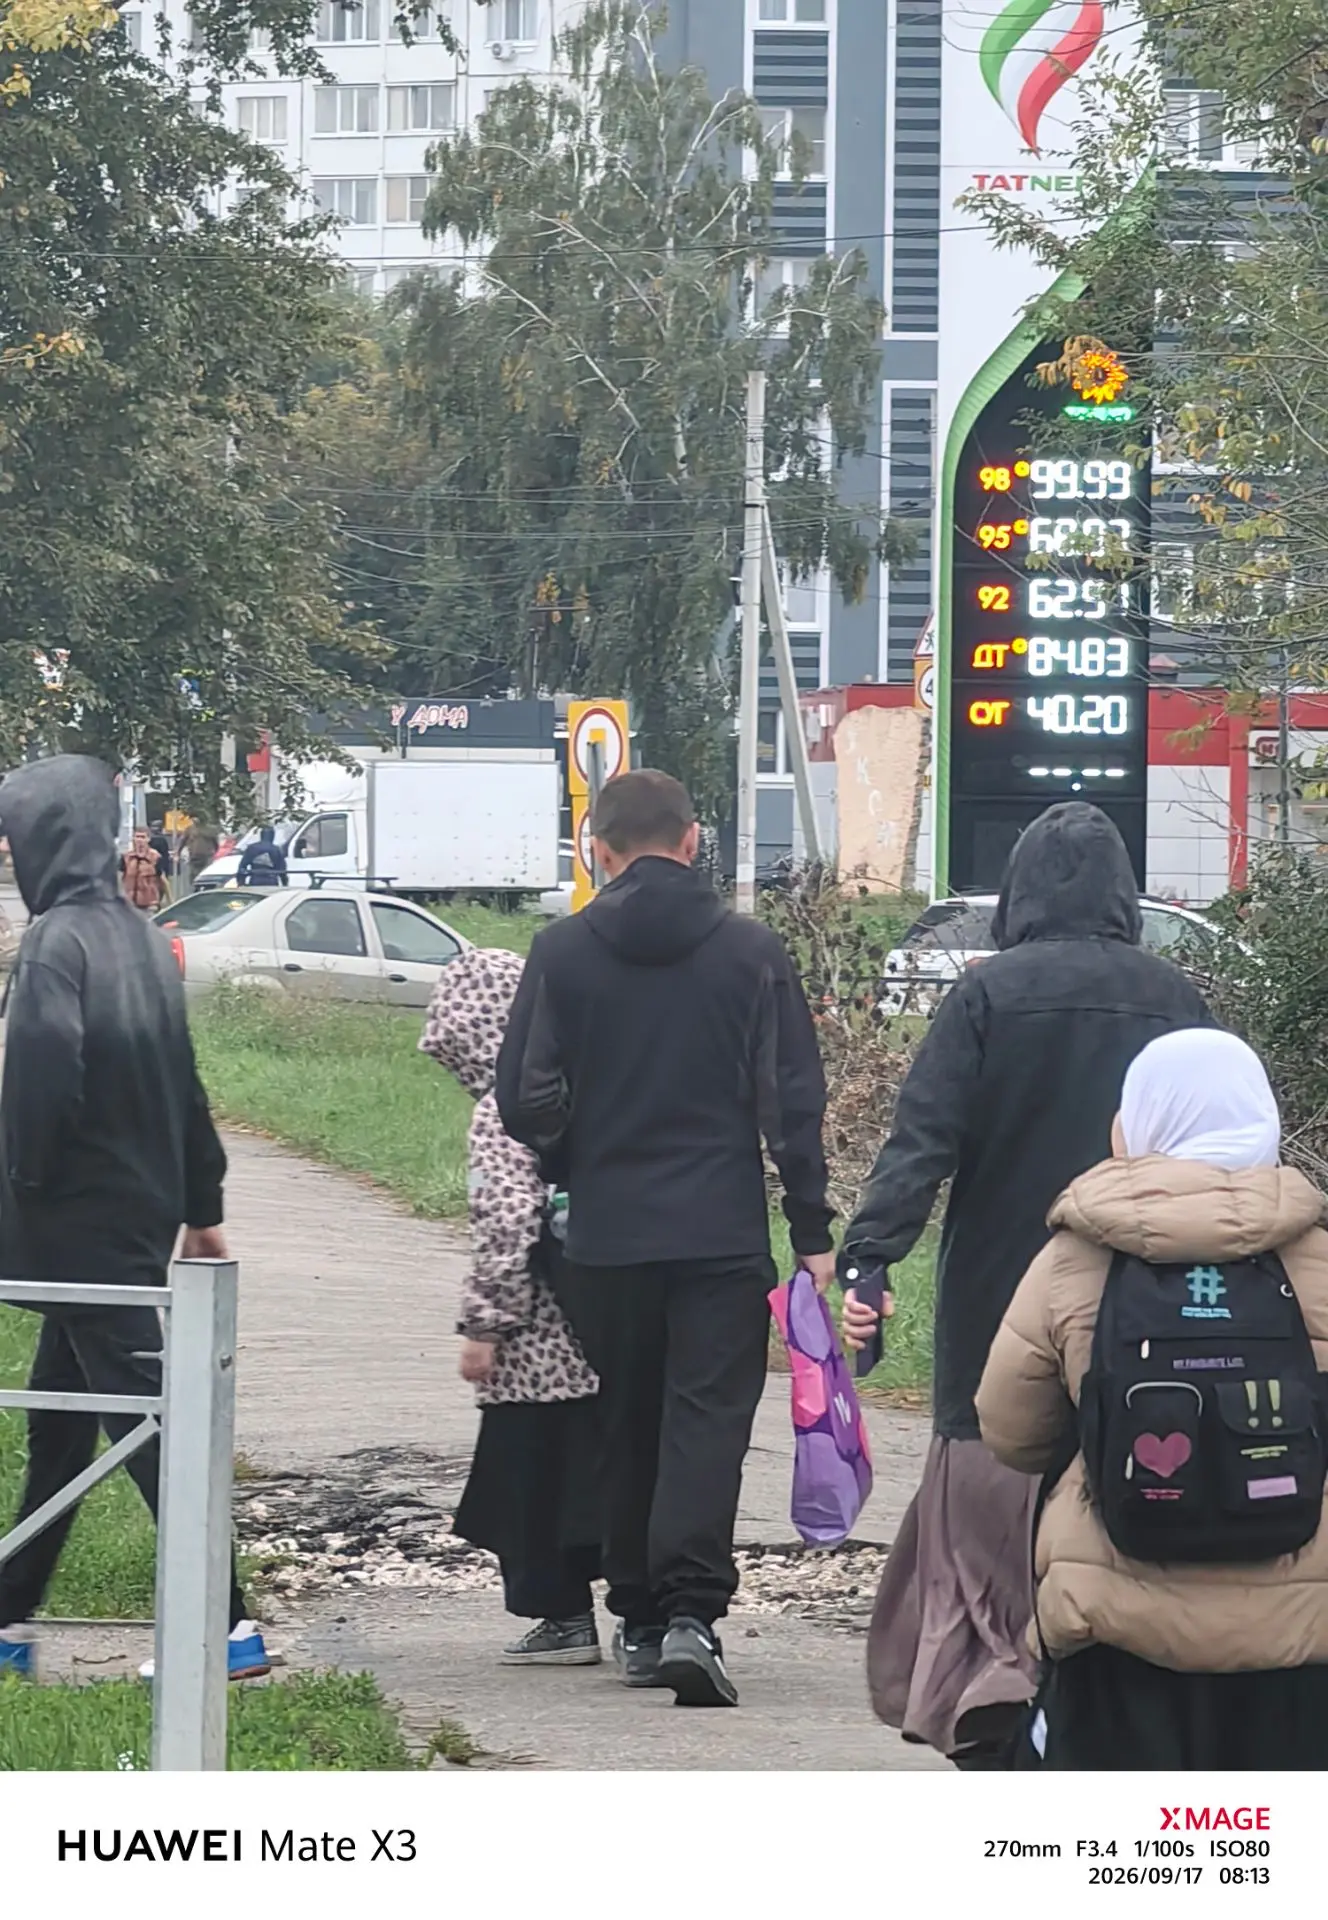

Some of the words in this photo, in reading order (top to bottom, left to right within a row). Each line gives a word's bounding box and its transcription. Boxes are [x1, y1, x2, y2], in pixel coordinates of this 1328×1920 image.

[1029, 459, 1131, 500] 99.99
[978, 586, 1010, 610] 92
[1028, 637, 1129, 677] 84.83
[391, 704, 408, 726] У
[407, 704, 469, 734] ДОМА
[1027, 694, 1128, 735] 40.20
